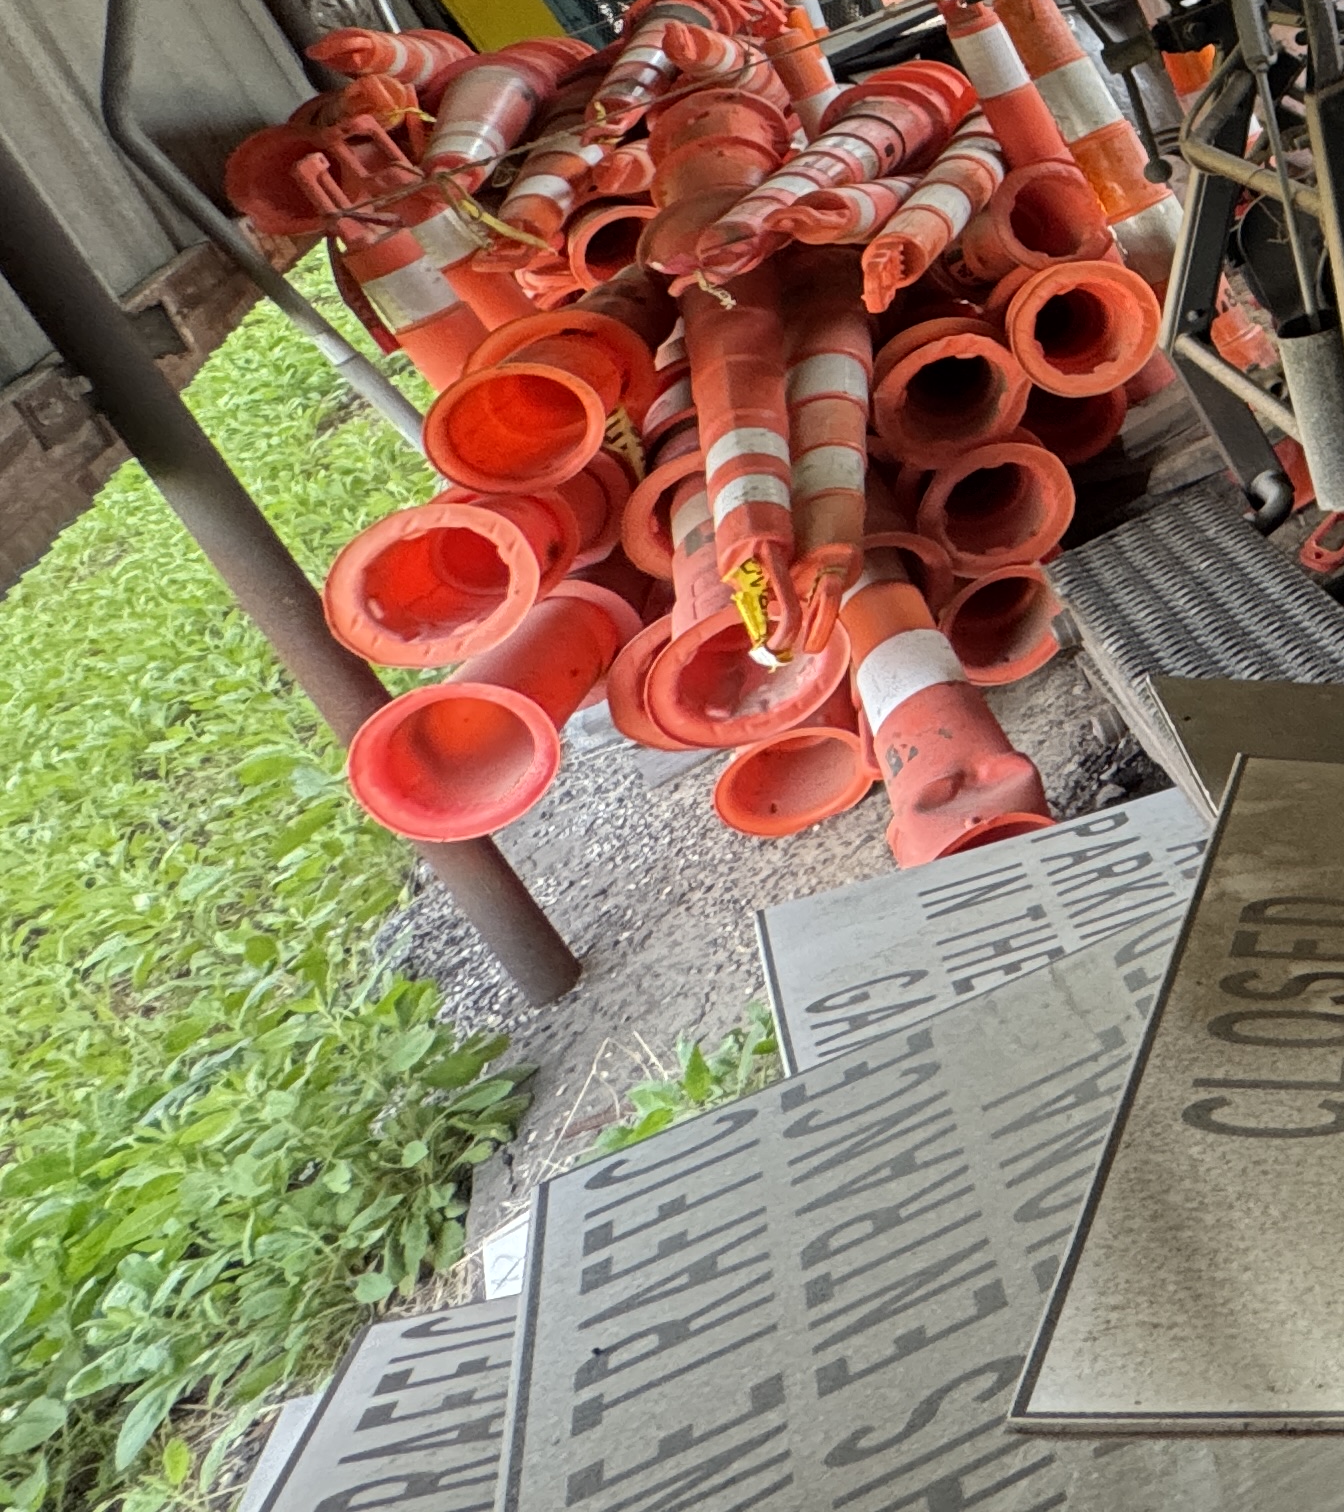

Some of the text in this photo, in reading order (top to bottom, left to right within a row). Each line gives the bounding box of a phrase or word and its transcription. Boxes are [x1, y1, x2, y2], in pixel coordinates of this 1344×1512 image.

[918, 861, 1065, 996] IN THE
[571, 1108, 778, 1437] TRAFFIC
[781, 1027, 1008, 1398] ENTRANCE
[315, 1315, 516, 1512] RAFFIC
